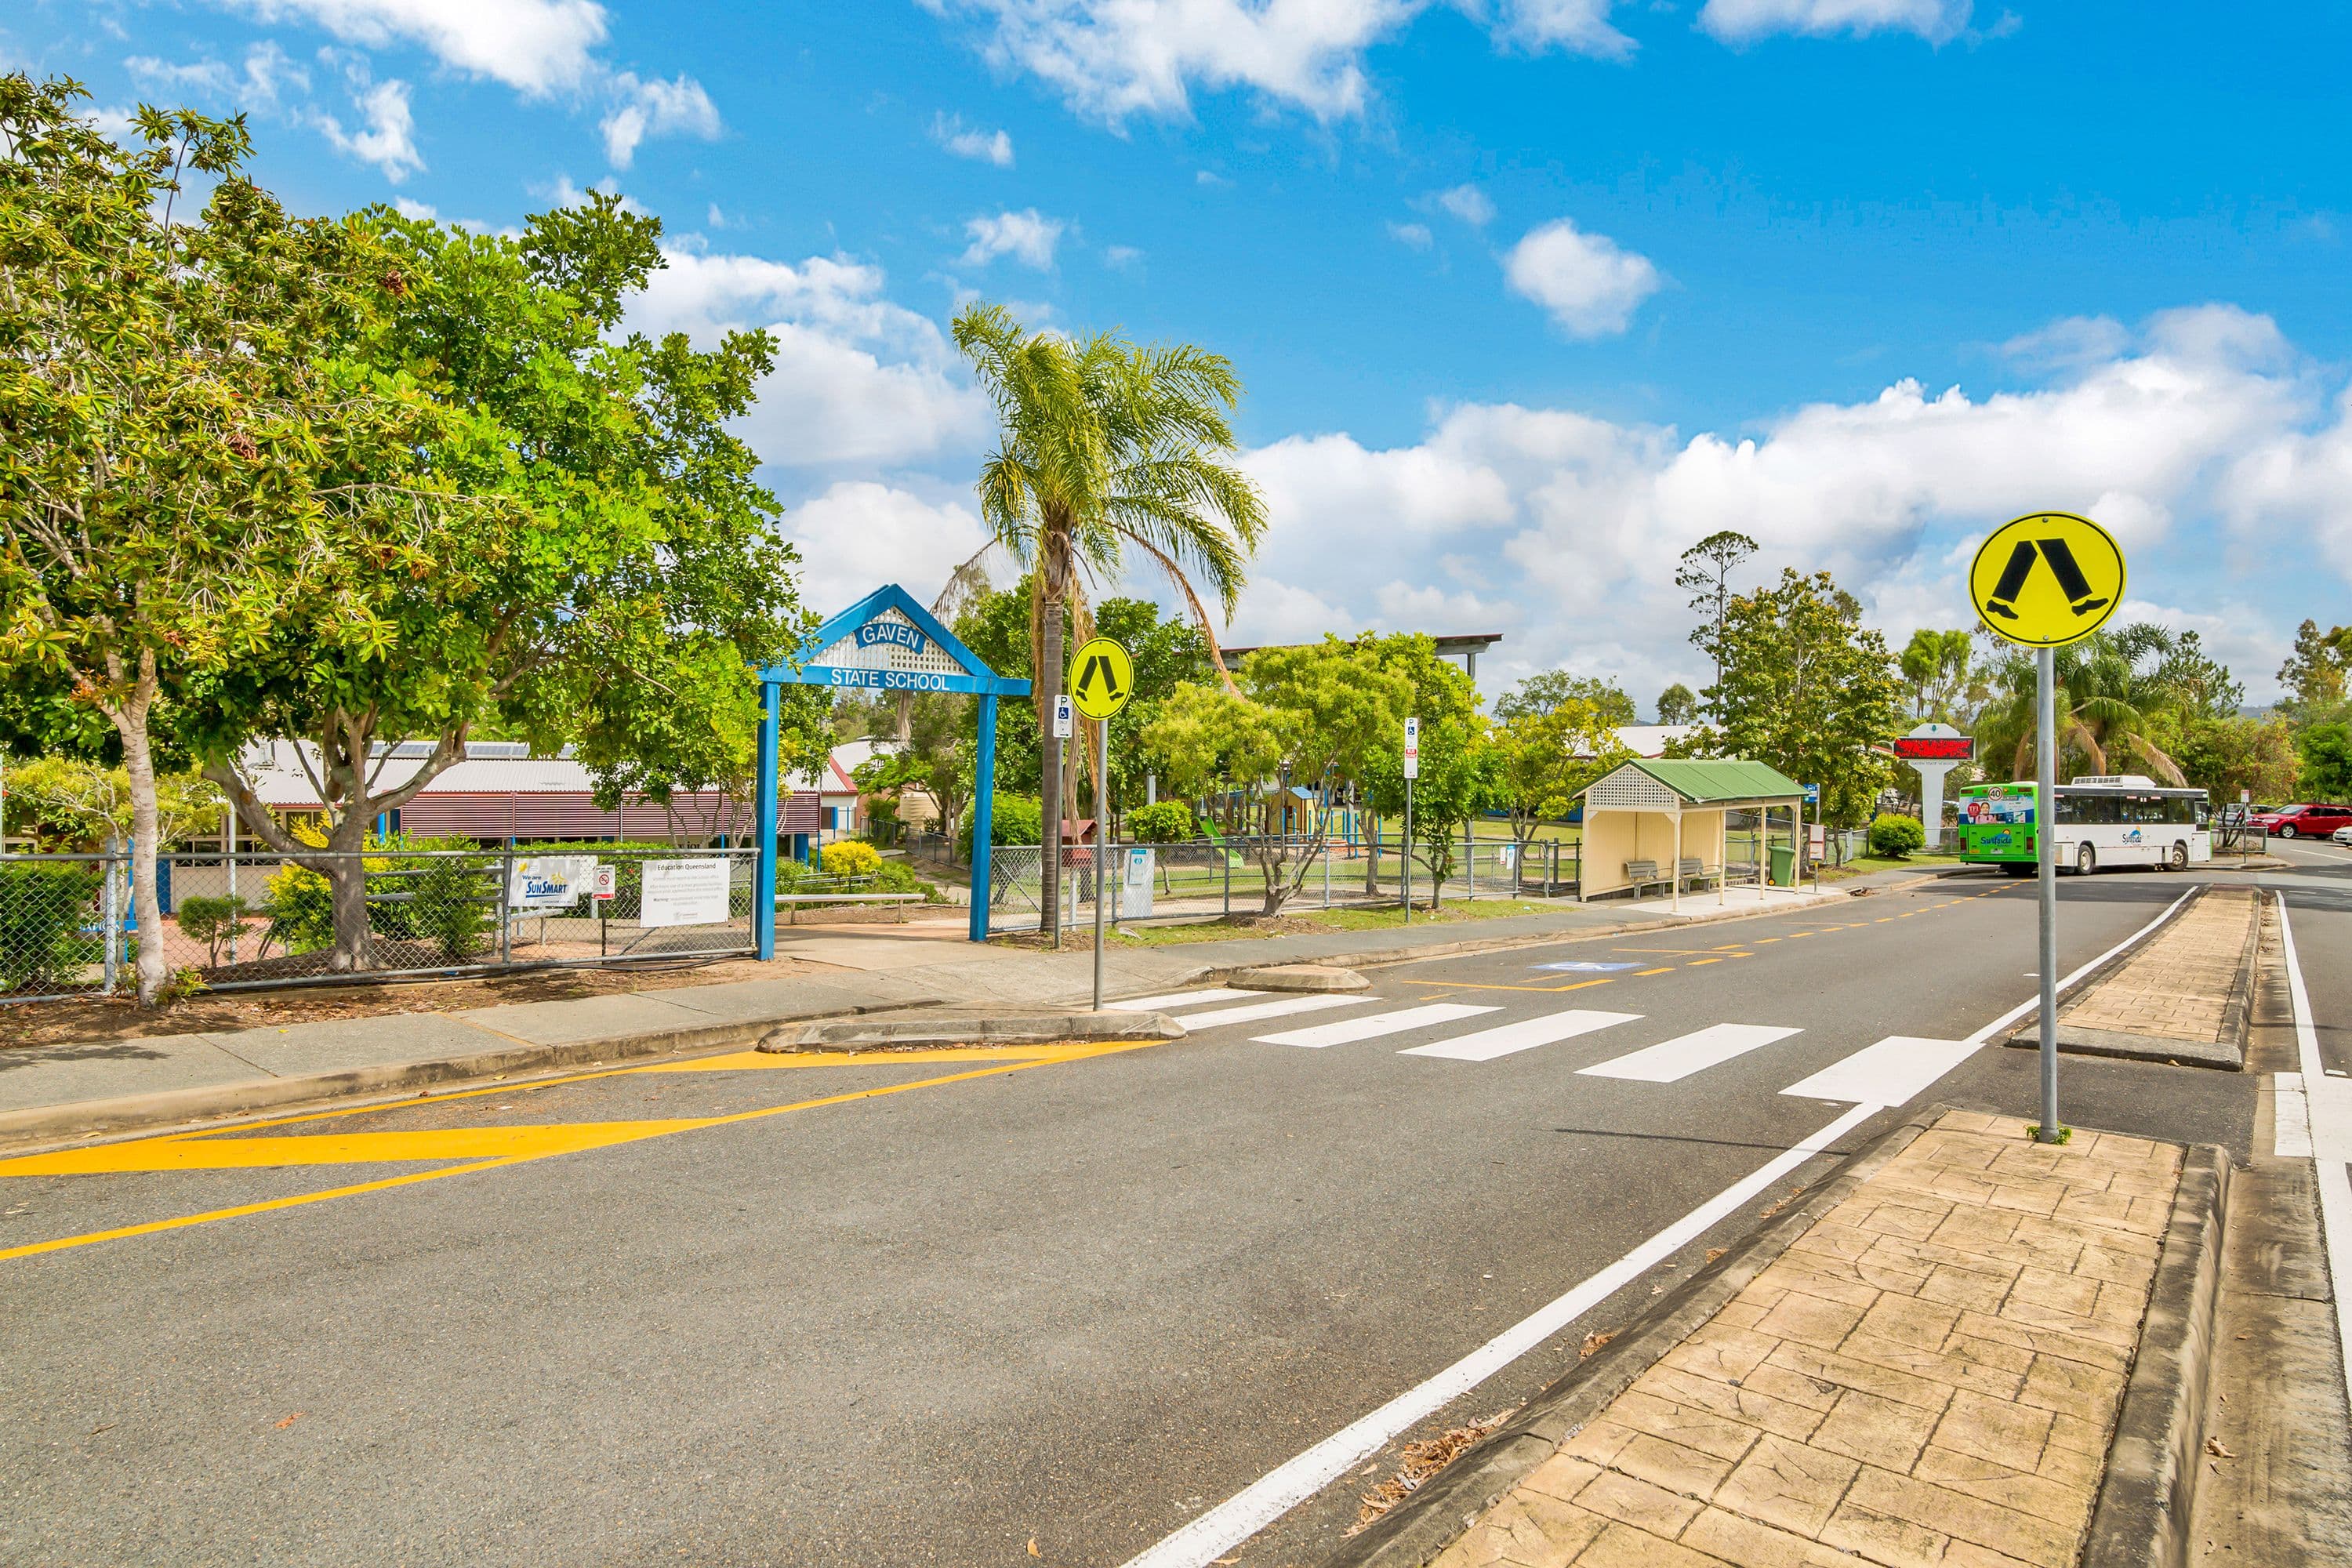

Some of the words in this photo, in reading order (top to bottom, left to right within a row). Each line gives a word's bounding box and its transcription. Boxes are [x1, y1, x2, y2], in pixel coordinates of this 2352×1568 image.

[862, 625, 920, 648] GAVEN
[831, 669, 879, 688] STATE
[885, 672, 950, 691] SCHOOL
[1061, 696, 1067, 706] P
[1980, 837, 2013, 845] Surfside
